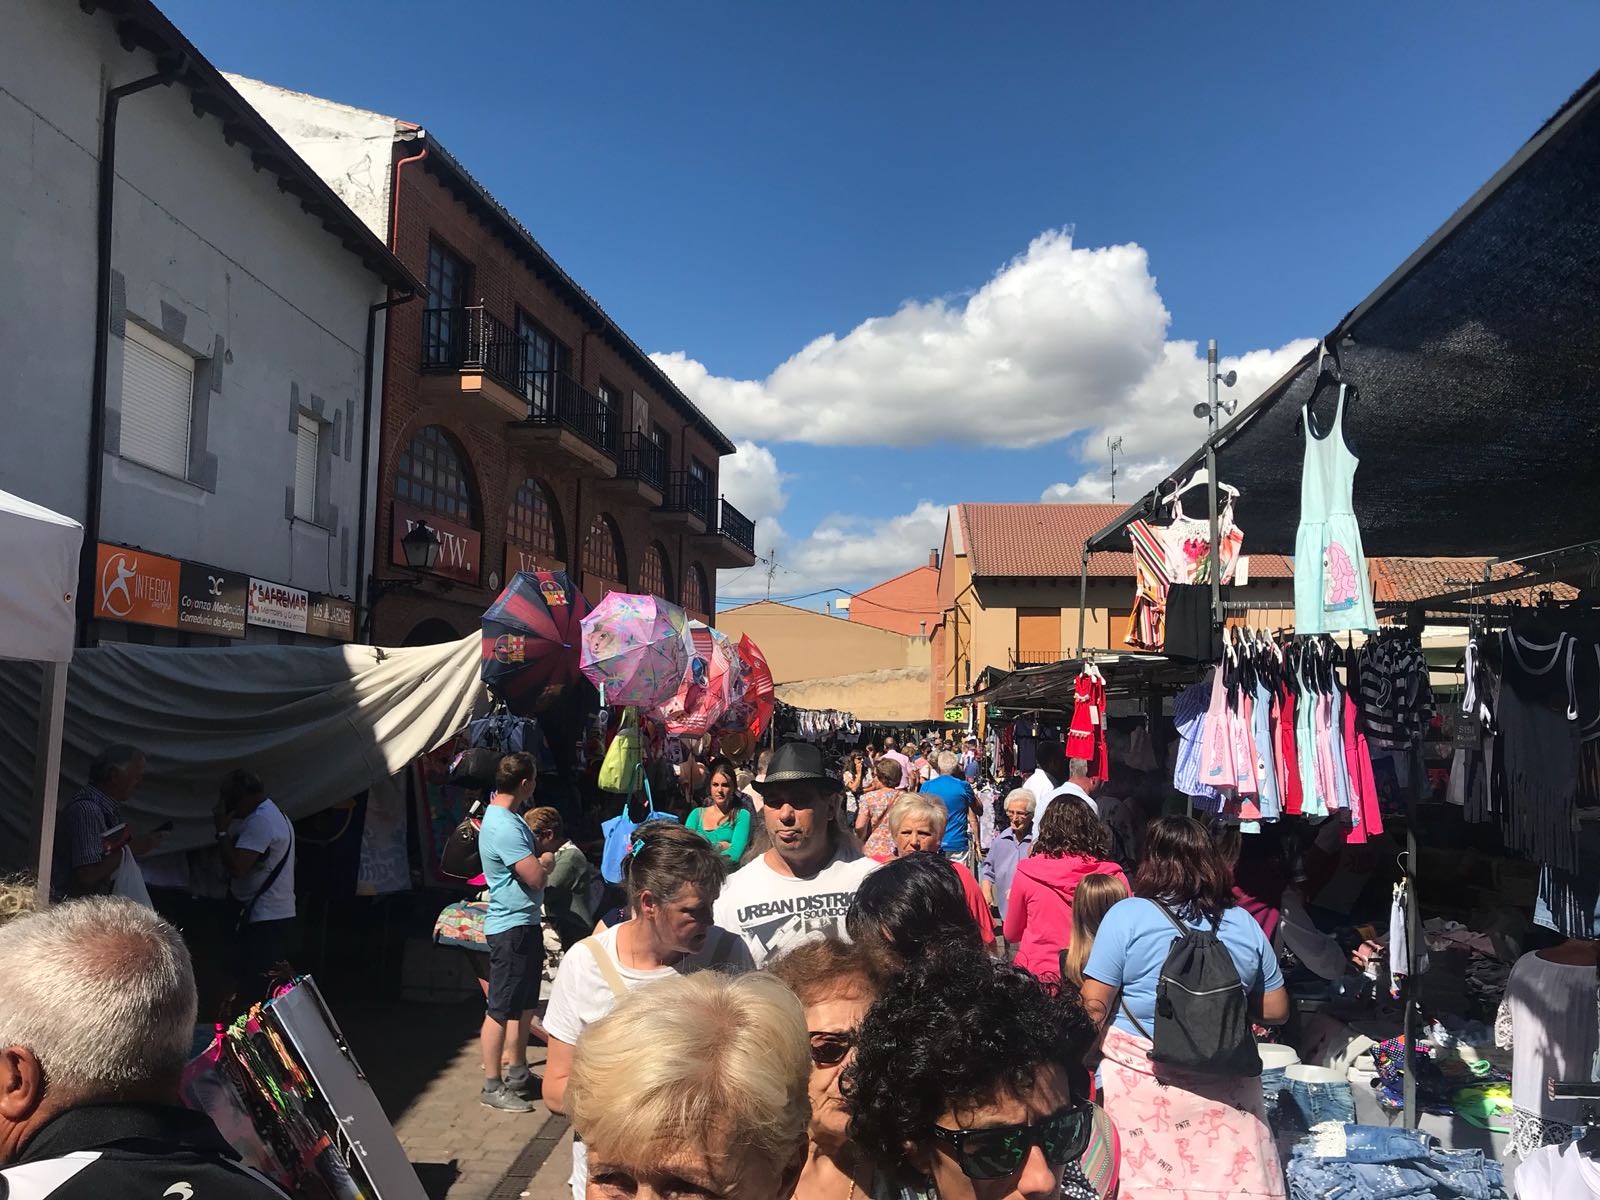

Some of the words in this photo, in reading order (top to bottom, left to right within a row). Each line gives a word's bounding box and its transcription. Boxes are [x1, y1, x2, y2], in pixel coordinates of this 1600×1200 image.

[134, 574, 172, 606] INTEGRA
[313, 602, 323, 618] LOS
[213, 617, 221, 627] de
[222, 618, 244, 631] Seguros
[737, 898, 794, 923] URBAN
[1128, 1127, 1145, 1139] PNTR
[1174, 1119, 1192, 1132] PNTR
[1156, 1158, 1174, 1175] PNTR
